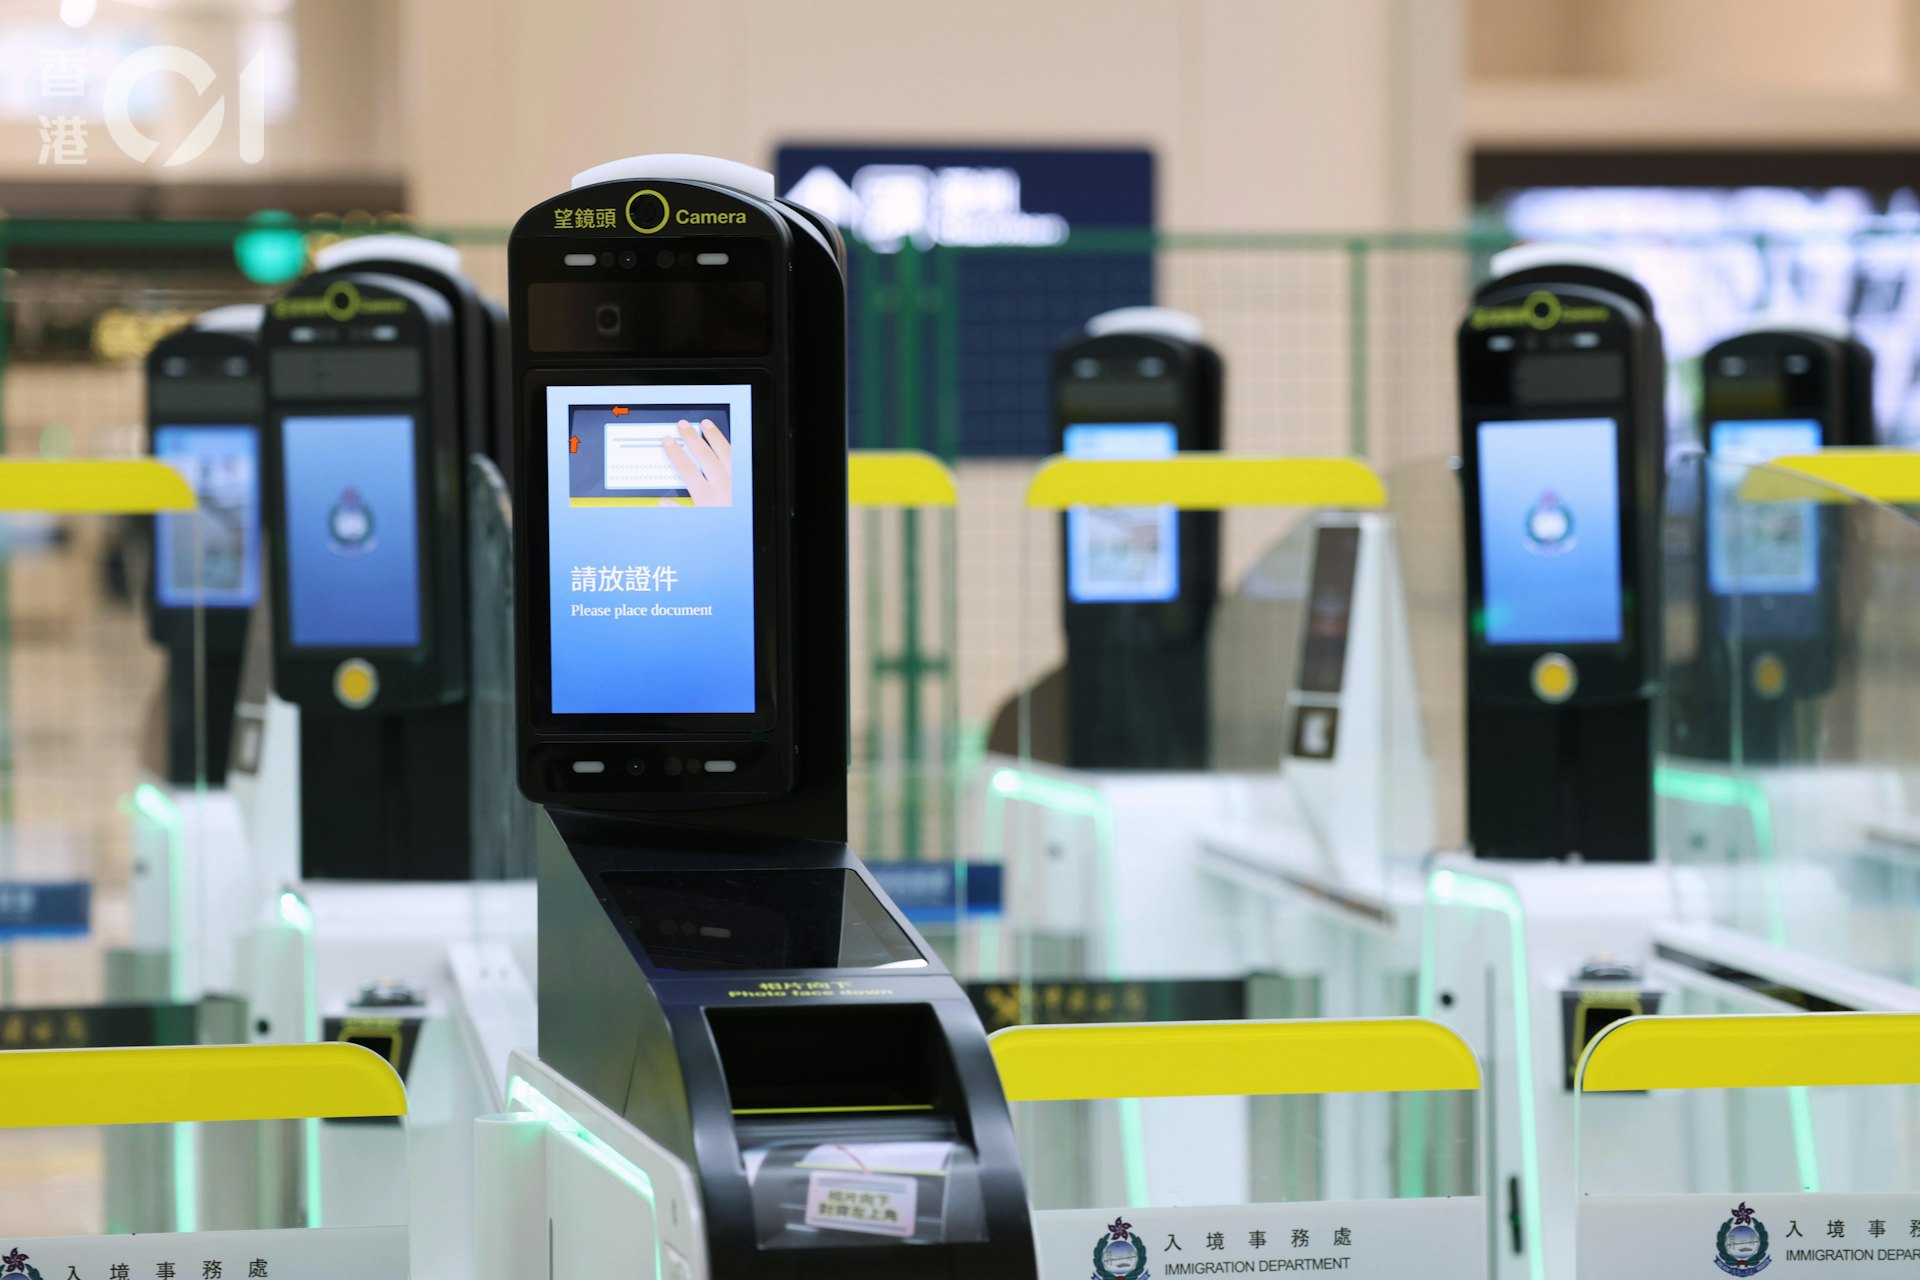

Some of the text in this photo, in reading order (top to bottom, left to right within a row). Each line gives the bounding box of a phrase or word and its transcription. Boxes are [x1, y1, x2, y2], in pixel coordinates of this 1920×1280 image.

[554, 208, 747, 229] 望鏡頭 Camera
[570, 565, 679, 592] 請放證件
[570, 603, 713, 619] Please place document
[728, 990, 787, 998] Photo
[1164, 1227, 1352, 1252] 入境事務處
[1786, 1249, 1874, 1262] IMMIGRATION
[67, 1258, 268, 1280] 入境事務處
[1165, 1257, 1351, 1276] IMMIGRATION DEPARTMENT
